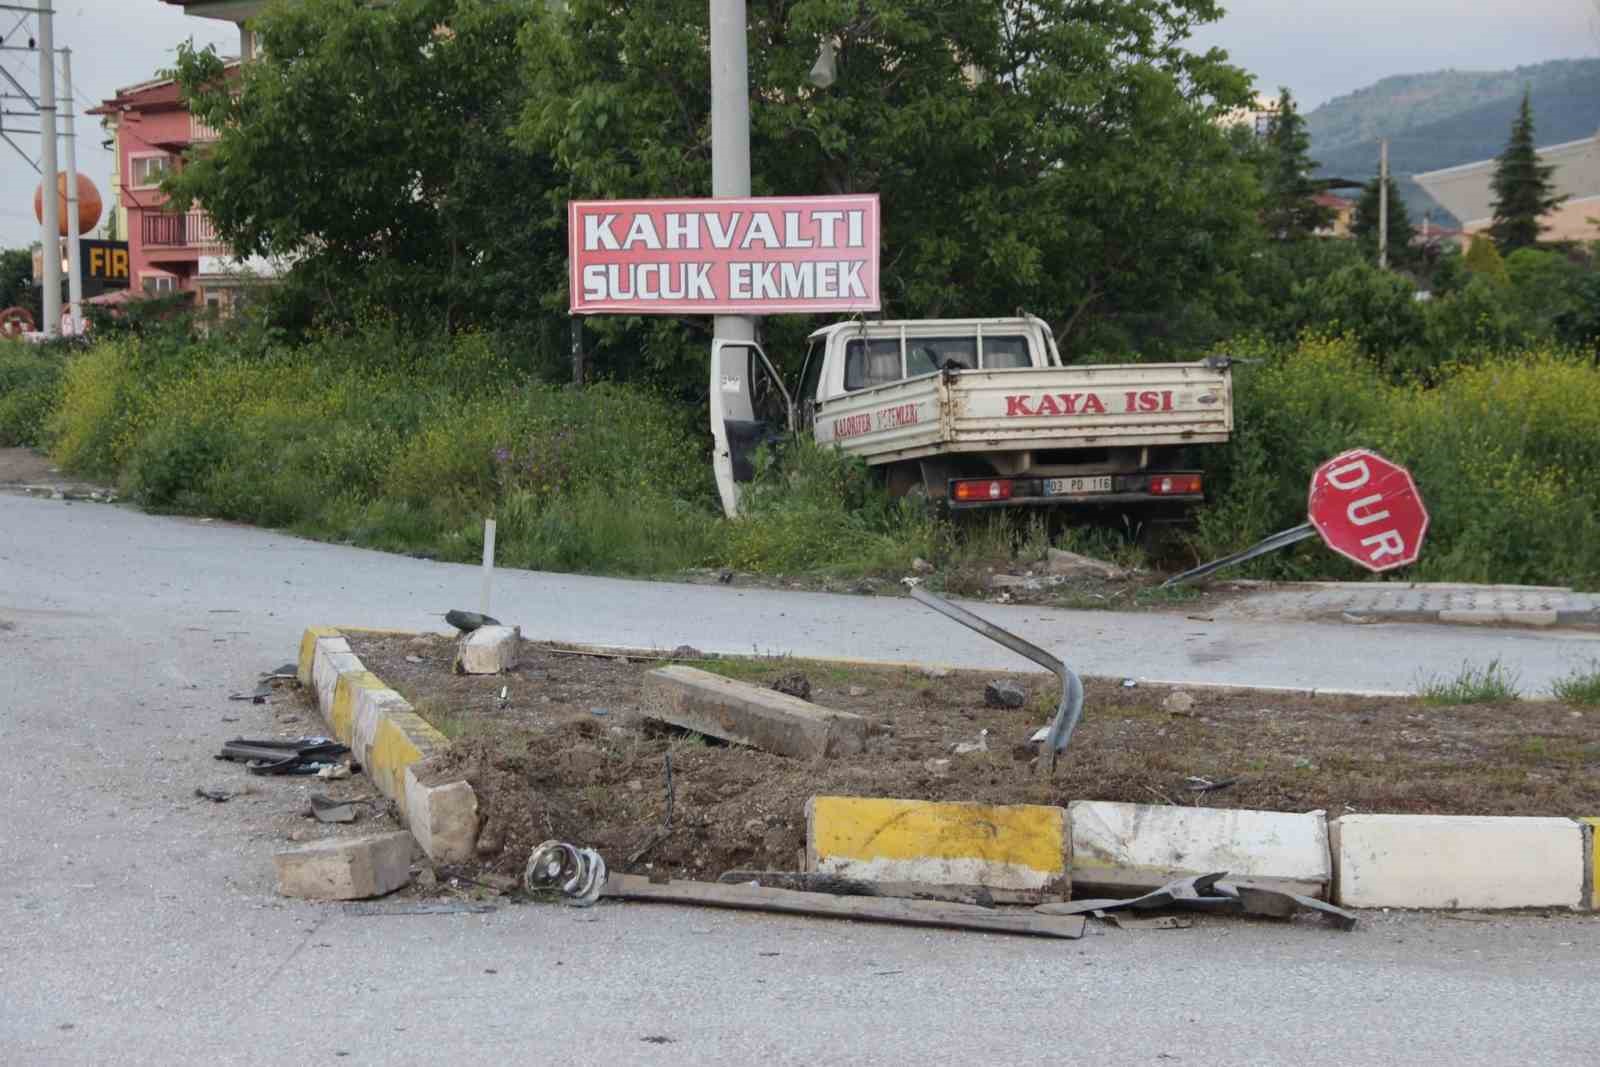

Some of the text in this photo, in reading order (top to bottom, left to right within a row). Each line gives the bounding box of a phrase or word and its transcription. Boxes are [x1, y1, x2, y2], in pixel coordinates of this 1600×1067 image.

[583, 210, 865, 251] KAHVALTI
[90, 247, 128, 277] FIR
[583, 260, 868, 301] SUCUK EKMEK
[1005, 392, 1105, 416] KAYA
[1125, 391, 1174, 412] ISI
[1327, 460, 1404, 560] DUR
